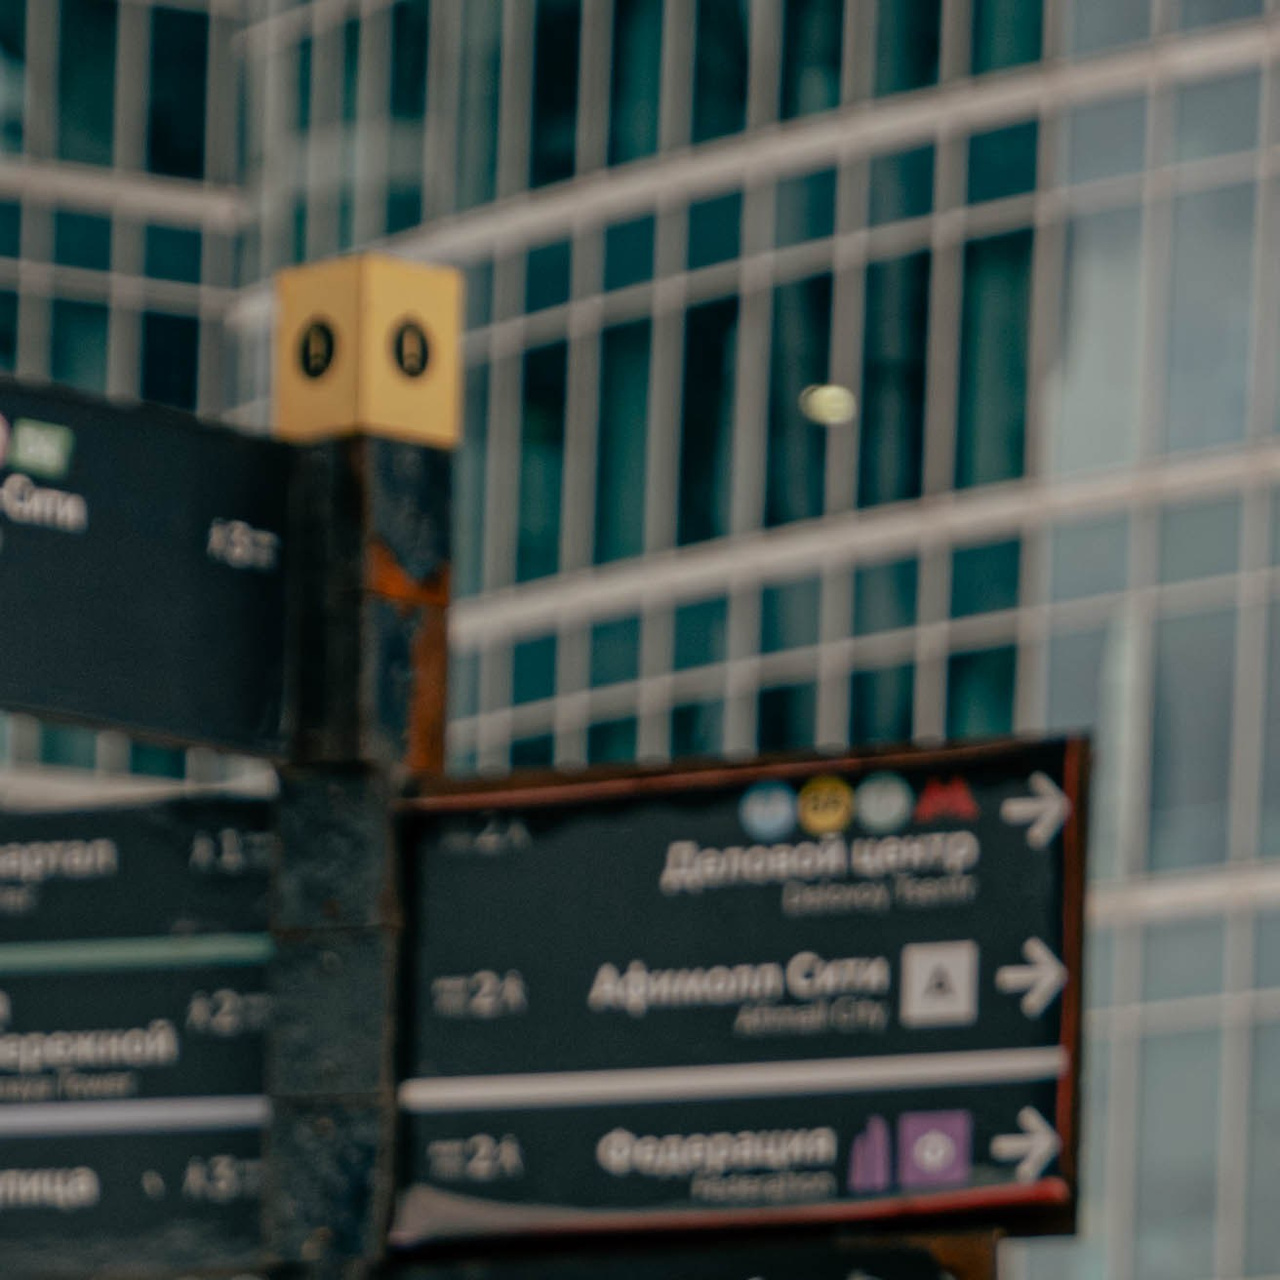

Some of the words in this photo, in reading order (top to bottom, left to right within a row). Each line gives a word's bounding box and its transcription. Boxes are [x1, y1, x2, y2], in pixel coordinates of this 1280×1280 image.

[662, 835, 846, 893] Деловой
[853, 832, 978, 876] центр
[589, 962, 782, 1015] Афимолл
[788, 953, 888, 997] Сити
[598, 1129, 836, 1174] Федерация
